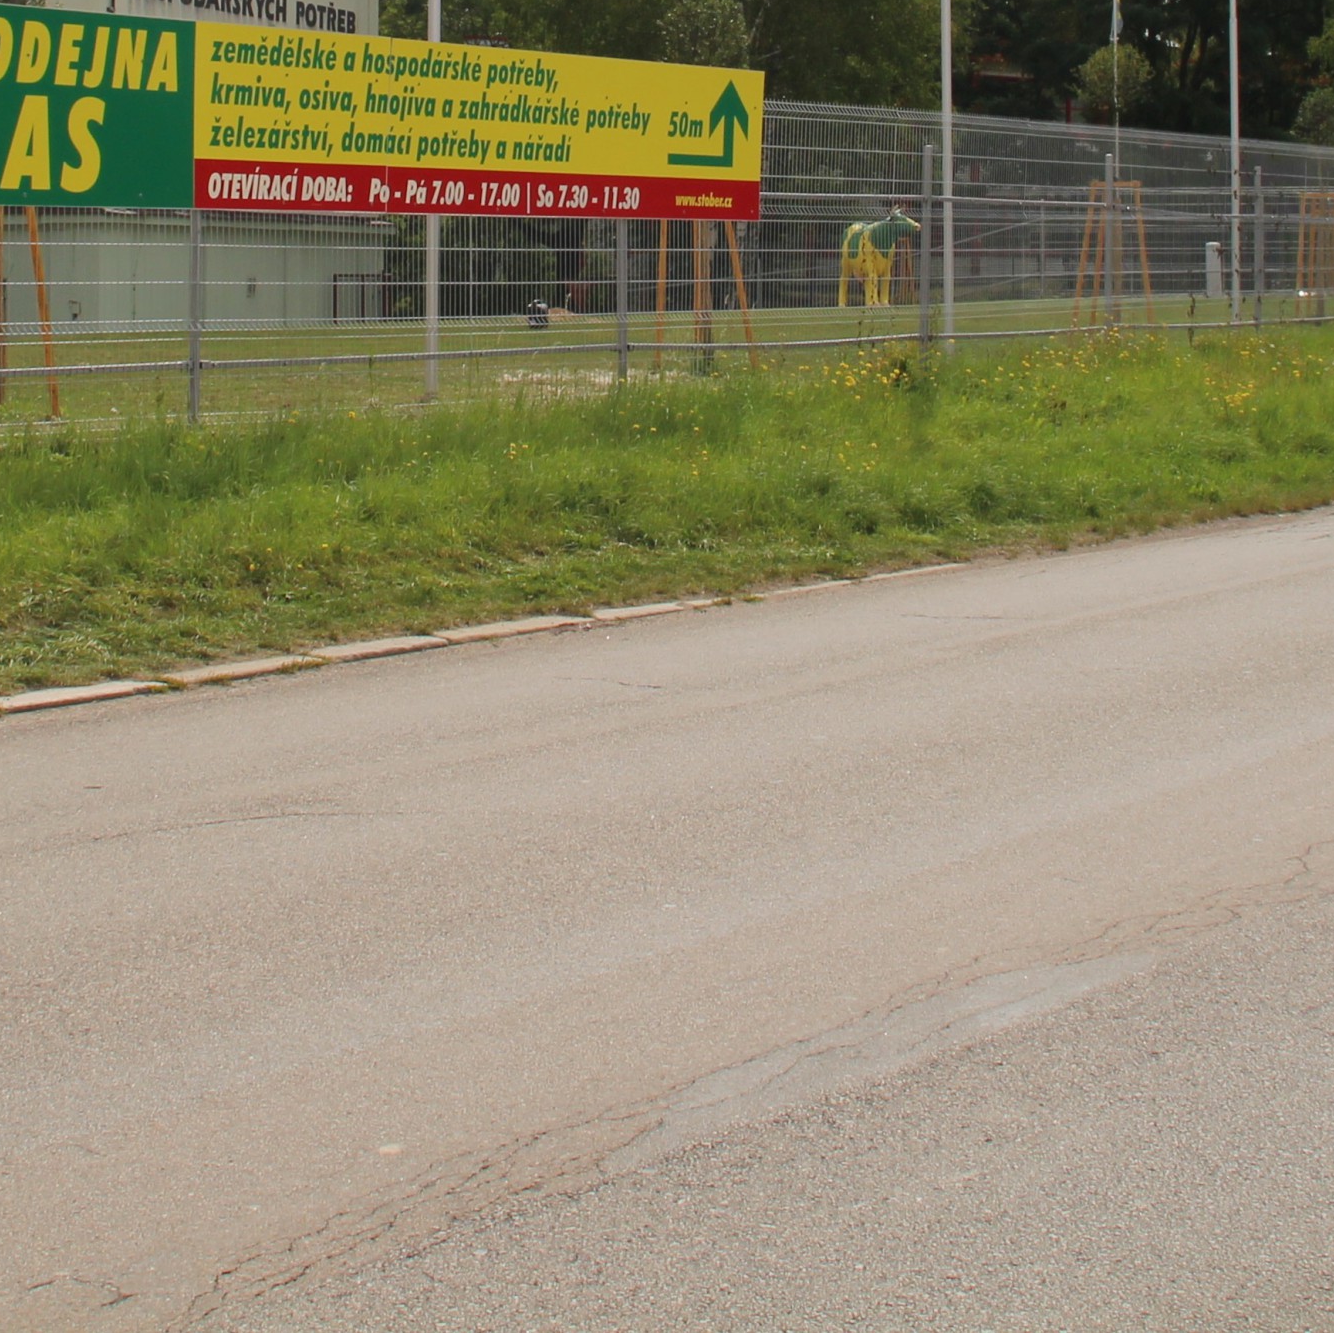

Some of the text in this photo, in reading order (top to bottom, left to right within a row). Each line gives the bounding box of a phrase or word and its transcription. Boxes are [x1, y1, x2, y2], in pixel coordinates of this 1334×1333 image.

[295, 1, 356, 34] POTŘEB
[211, 35, 558, 94] zemědělské a hospodářské potřeby,
[210, 72, 651, 136] krmiva, osiva, hnojiva a zahrádkářské potřeby
[668, 111, 703, 138] 50m
[209, 116, 571, 164] železářství, domácí potřeby a nářadí
[208, 167, 298, 201] OTEVÍRACÍ
[301, 176, 353, 203] DOBA:
[368, 178, 390, 203] Po
[405, 179, 427, 205] Pá
[431, 180, 465, 206] 7.00
[480, 182, 520, 207] 17.00
[536, 184, 554, 208] So
[558, 185, 588, 208] 7.30
[603, 186, 640, 209] 11.30
[675, 192, 733, 208] www.stober.cz
